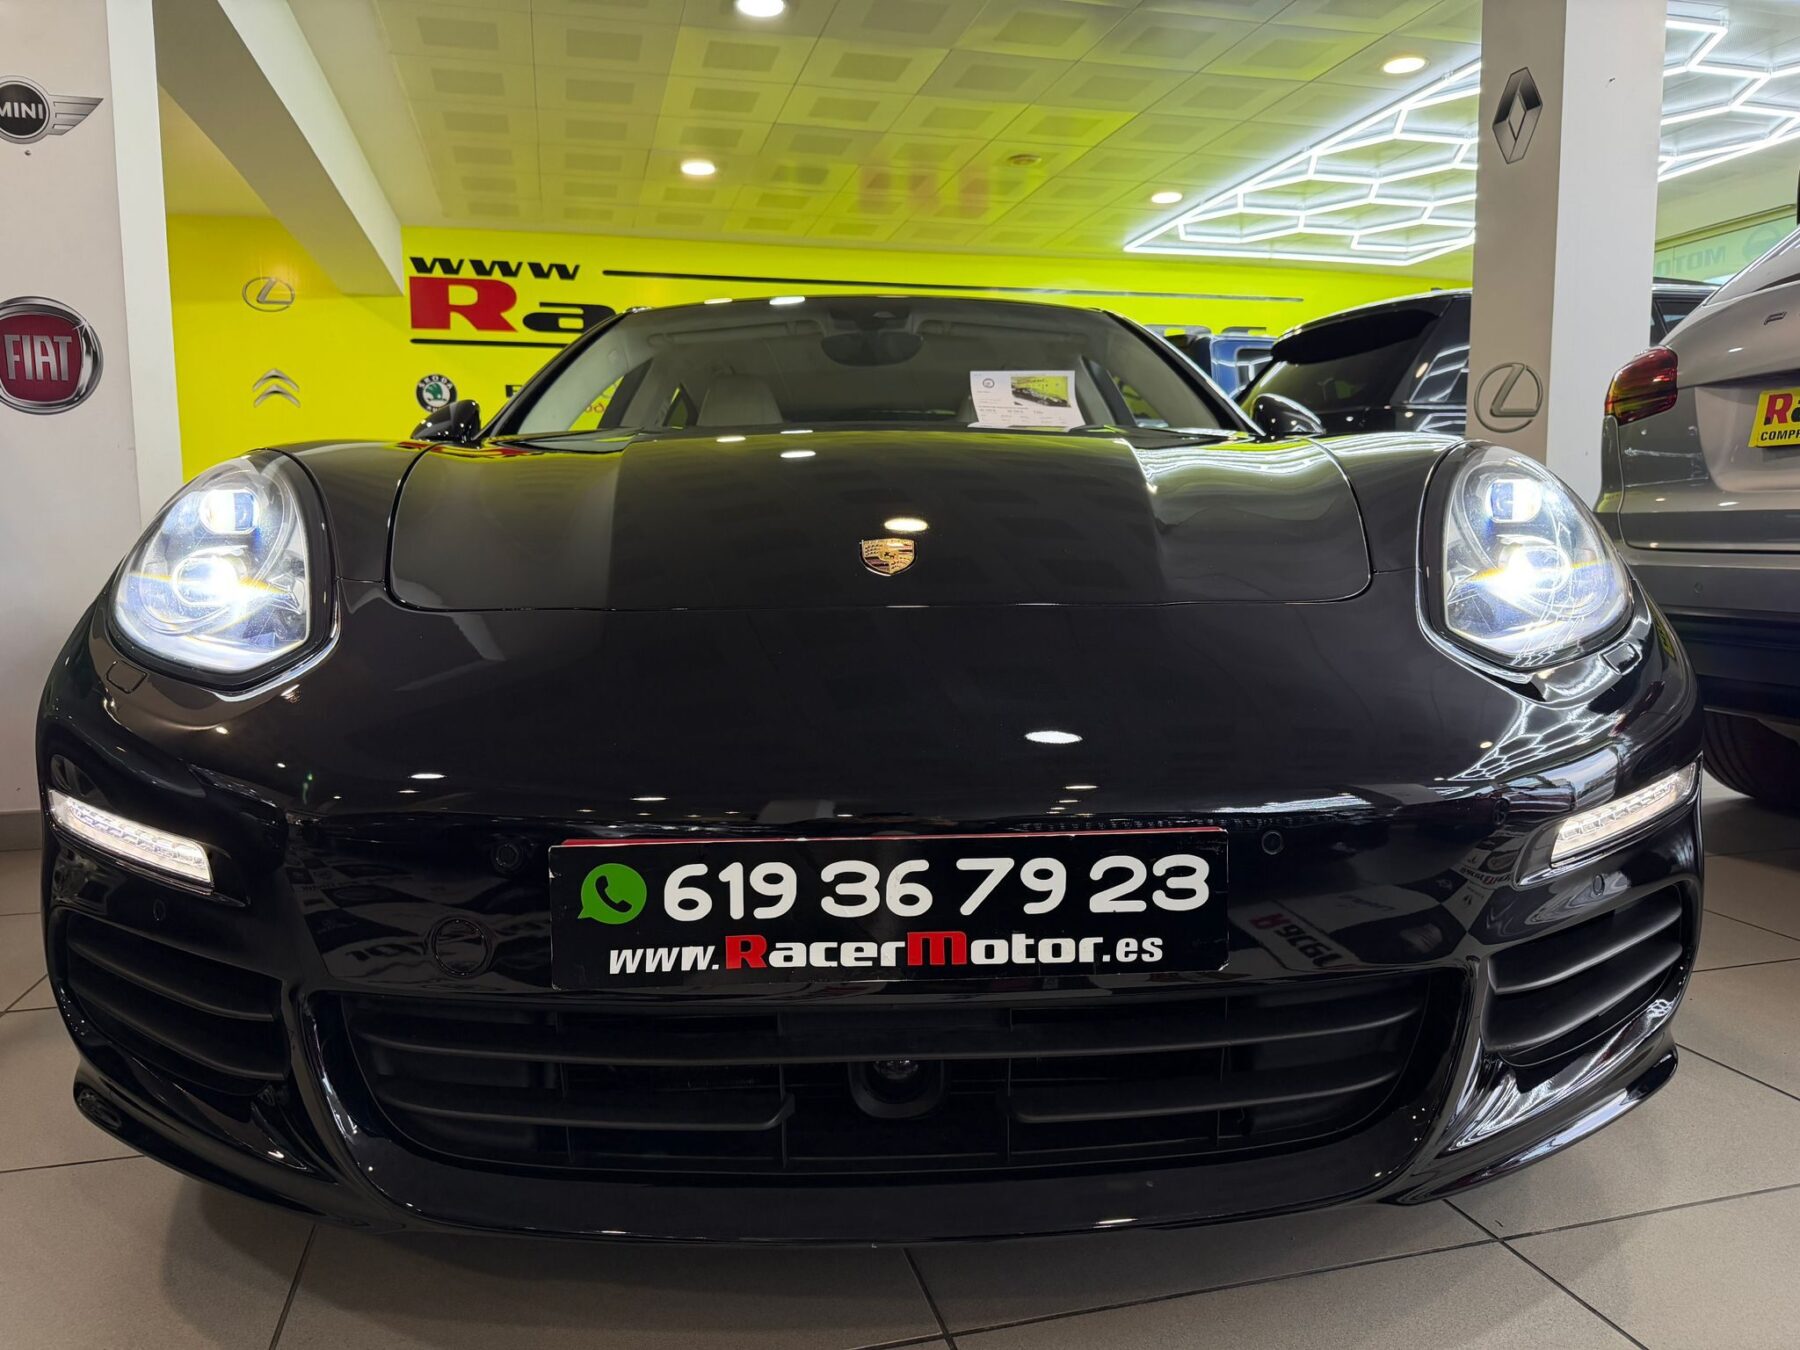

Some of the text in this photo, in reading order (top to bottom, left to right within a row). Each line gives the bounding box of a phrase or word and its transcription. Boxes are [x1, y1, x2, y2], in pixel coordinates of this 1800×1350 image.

[0, 101, 44, 120] MINI
[4, 334, 72, 381] FIAT
[664, 854, 1210, 922] 619 36 79 23
[609, 930, 1163, 975] www.RacerMotor.es
